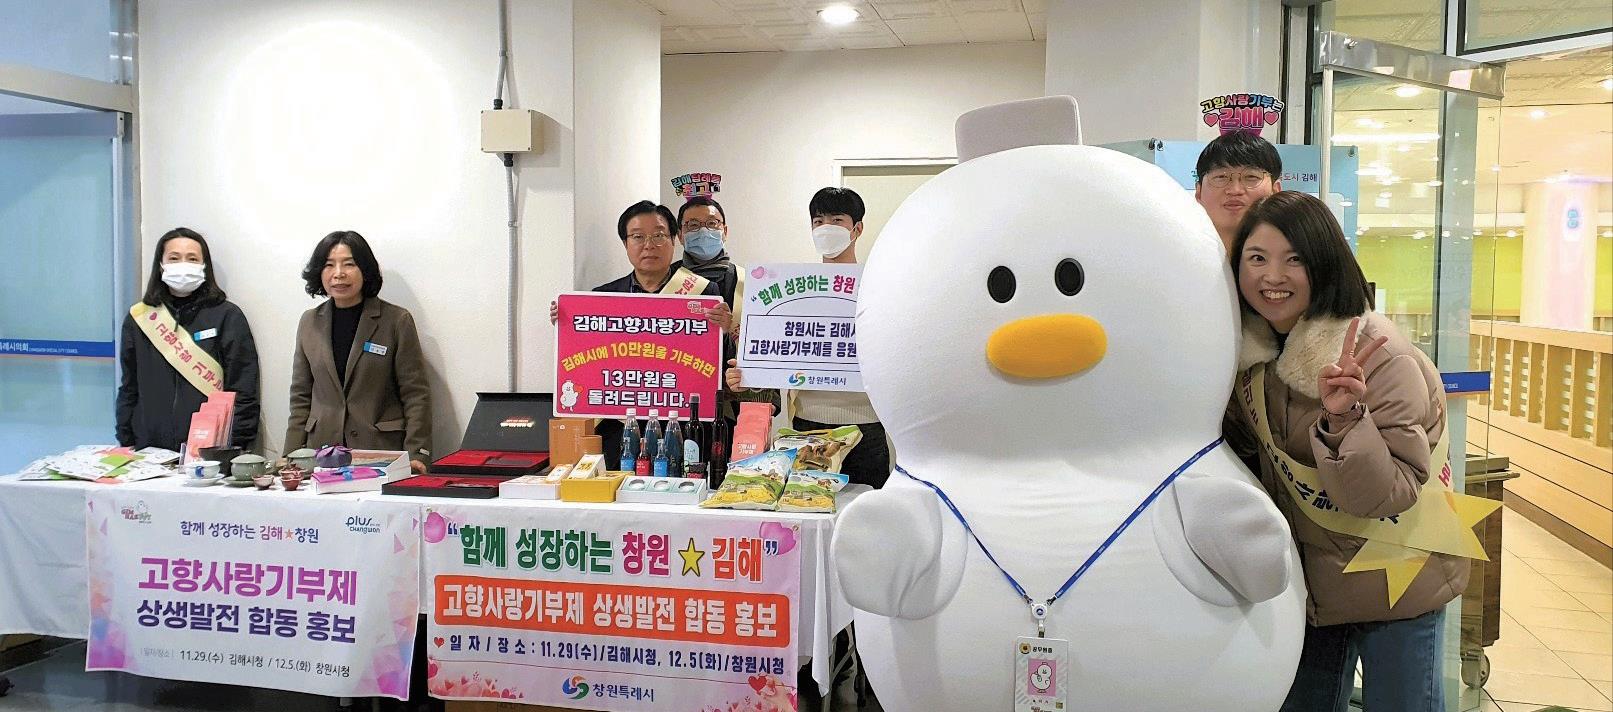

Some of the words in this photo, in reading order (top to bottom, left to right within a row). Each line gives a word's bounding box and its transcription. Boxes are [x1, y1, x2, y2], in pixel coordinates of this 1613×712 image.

[1200, 94, 1284, 113] 고향사랑기부는
[1220, 106, 1264, 128] 김해
[1280, 172, 1299, 181] 도시
[1302, 172, 1318, 182] 김해
[784, 274, 829, 295] 성장하는
[833, 274, 855, 294] 창원
[573, 315, 709, 336] 김해고향사랑기부
[784, 321, 826, 338] 창원시는
[749, 339, 832, 357] 고향사랑기부제를
[561, 345, 609, 372] 김해시에
[610, 342, 666, 360] 10만원을
[671, 349, 716, 378] 기부하면
[602, 370, 677, 389] 13만원을
[807, 374, 847, 386] 창원특례시
[588, 389, 690, 409] 돌려드립니다.
[180, 520, 204, 536] 함께
[208, 522, 256, 540] 성장하는
[259, 525, 283, 541] 김해
[295, 527, 319, 544] 창원
[515, 528, 613, 574] 성장하는
[621, 531, 671, 577] 창원
[138, 557, 357, 605] 고향사랑기부제
[136, 599, 240, 633] 상생발전
[247, 606, 299, 636] 합동
[305, 610, 356, 643] 홍보
[442, 584, 584, 626] 고향사랑기부제
[593, 593, 675, 632] 상생발전
[684, 600, 727, 636] 합동
[735, 601, 777, 638] 홍보
[229, 655, 264, 668] 김해시청
[315, 663, 351, 678] 창원시청
[592, 683, 655, 702] 창원특례시
